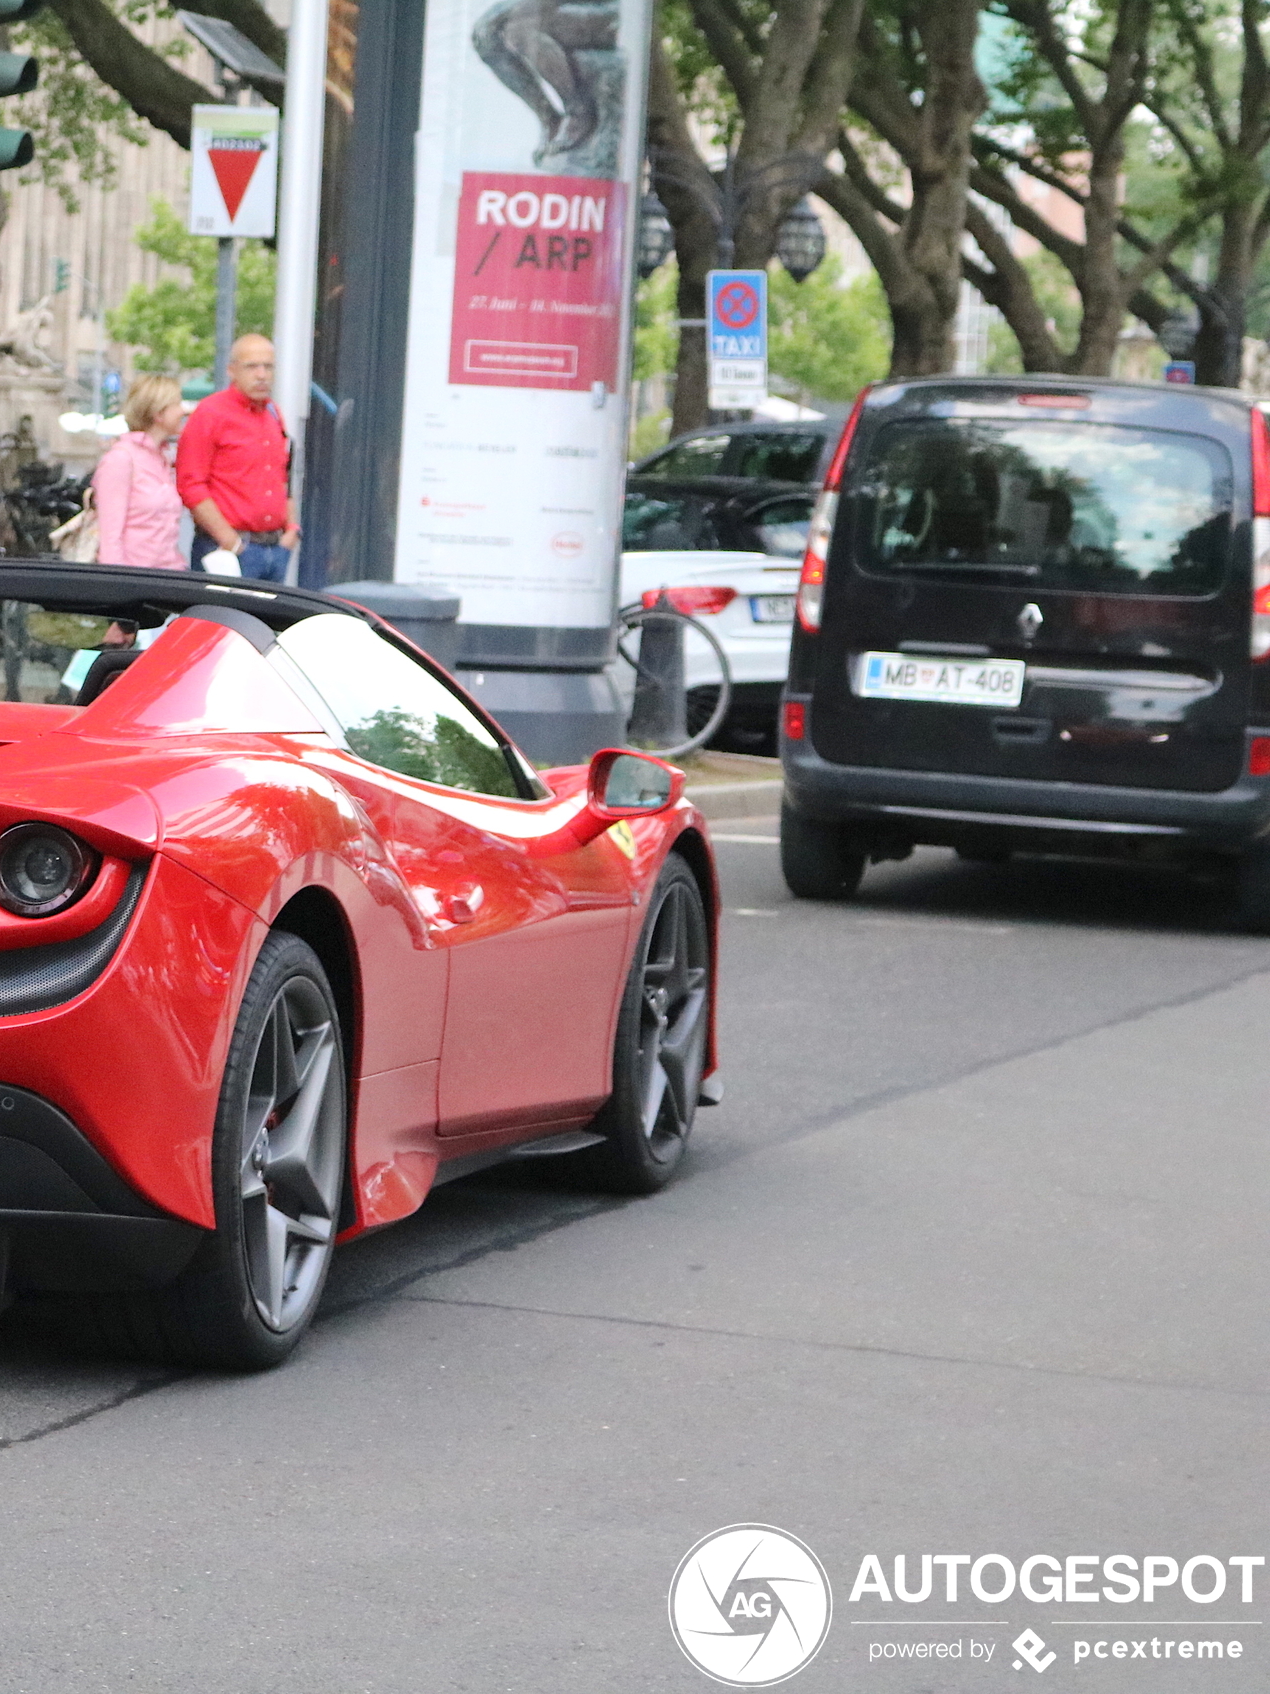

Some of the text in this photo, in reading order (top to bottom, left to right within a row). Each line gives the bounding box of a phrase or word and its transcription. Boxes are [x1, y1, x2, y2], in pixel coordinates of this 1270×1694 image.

[477, 190, 606, 232] RODIN
[515, 233, 593, 272] ARP
[712, 335, 761, 356] TAXI
[885, 663, 1016, 693] MB AT-408
